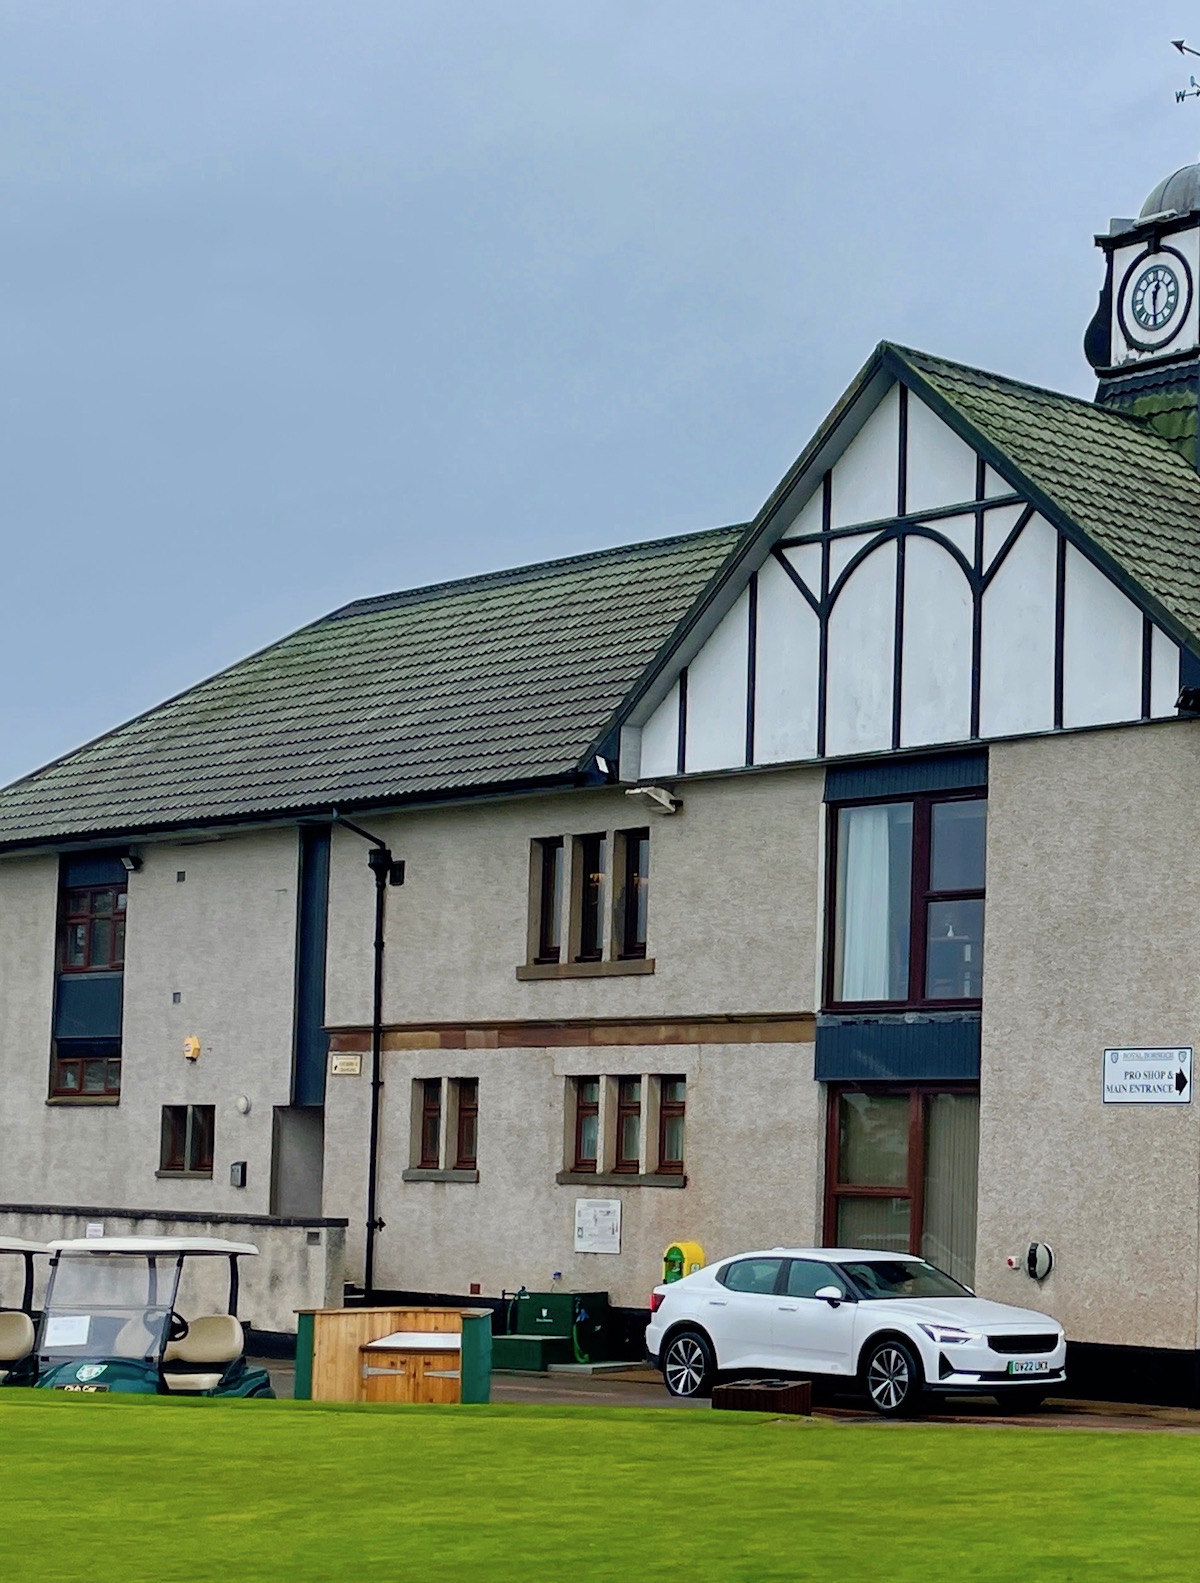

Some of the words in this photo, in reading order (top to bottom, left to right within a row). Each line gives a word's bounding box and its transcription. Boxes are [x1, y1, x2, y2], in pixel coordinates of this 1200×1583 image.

[1175, 89, 1186, 103] W
[1124, 1071, 1141, 1080] PRO
[1143, 1071, 1166, 1080] SHOP
[1167, 1070, 1174, 1080] &
[1106, 1084, 1128, 1093] MAIN
[1129, 1084, 1174, 1093] ENTRANCE
